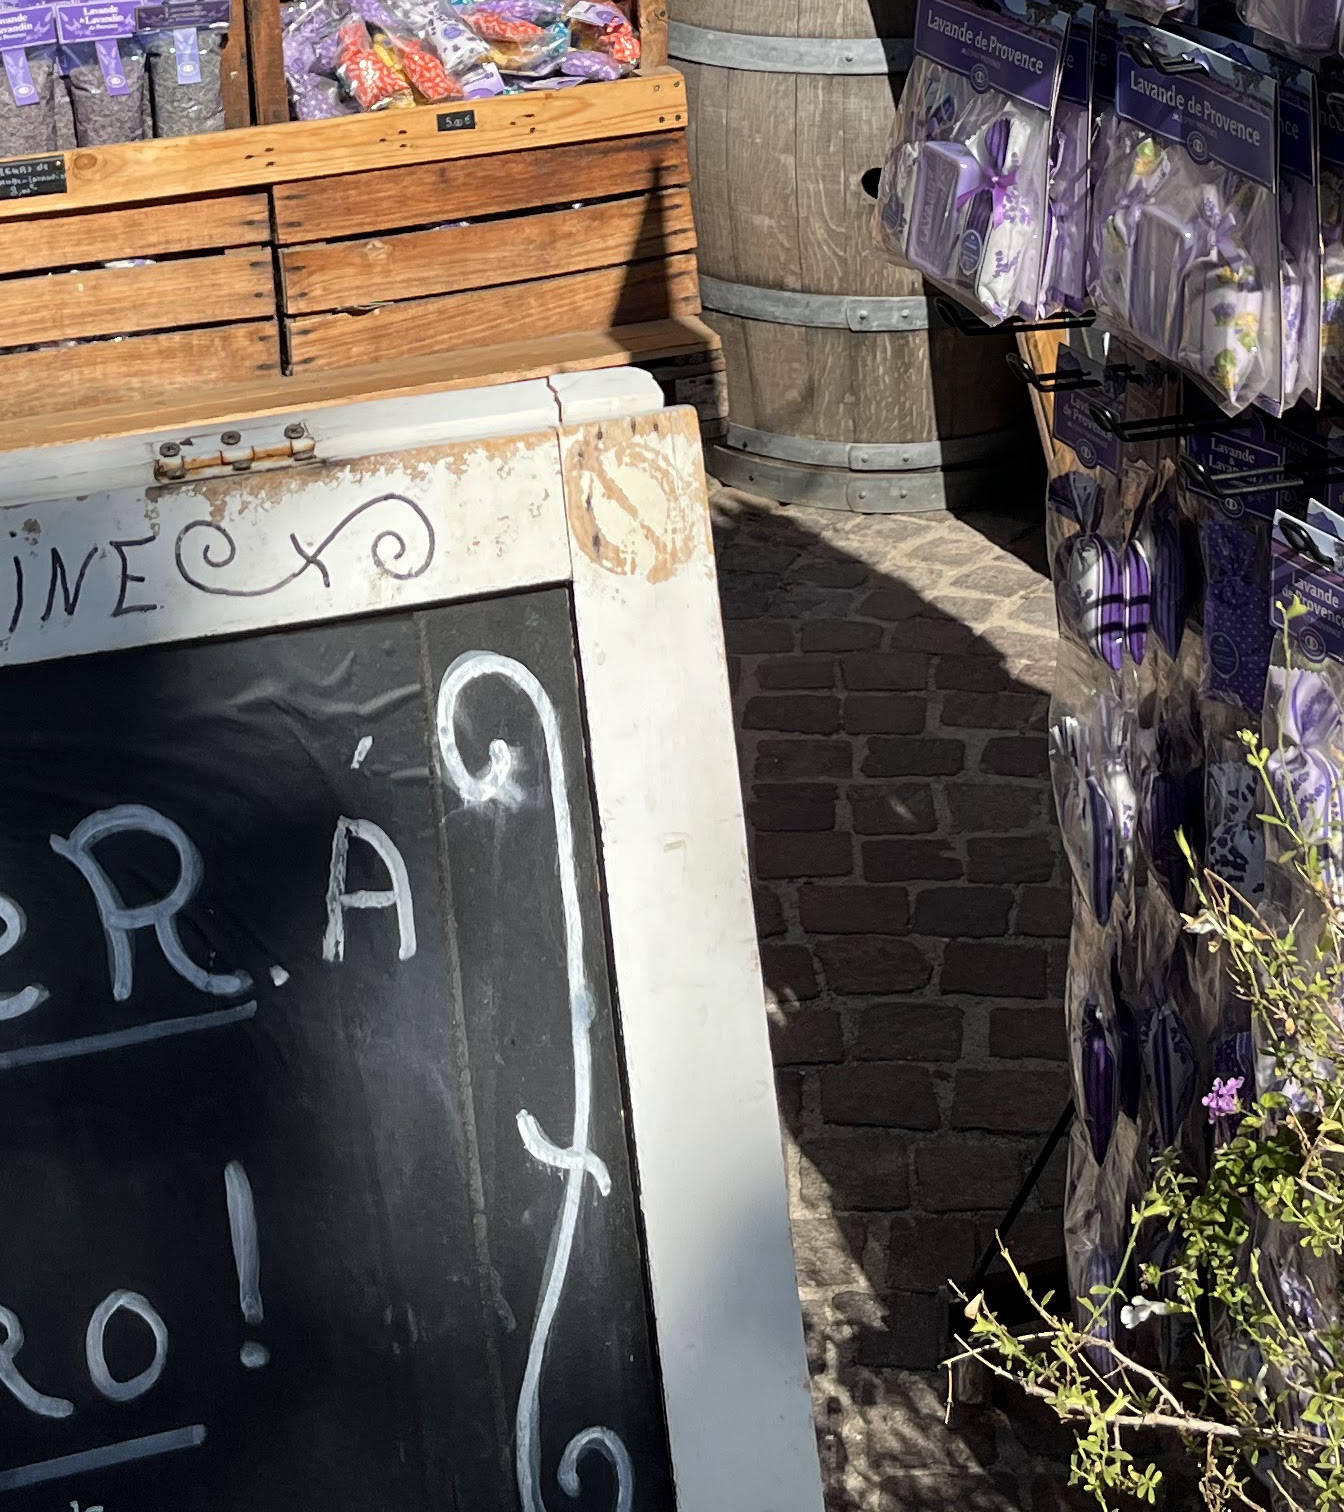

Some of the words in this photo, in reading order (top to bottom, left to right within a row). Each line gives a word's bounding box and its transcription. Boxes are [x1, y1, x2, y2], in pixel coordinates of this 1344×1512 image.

[927, 9, 973, 45] Lavande
[974, 31, 988, 51] de
[988, 36, 1044, 75] Provence
[1130, 70, 1185, 110] Lavande
[1187, 96, 1202, 117] de
[1203, 100, 1261, 146] Provence
[1210, 437, 1256, 465] Lavande
[1291, 570, 1340, 609] Lavande
